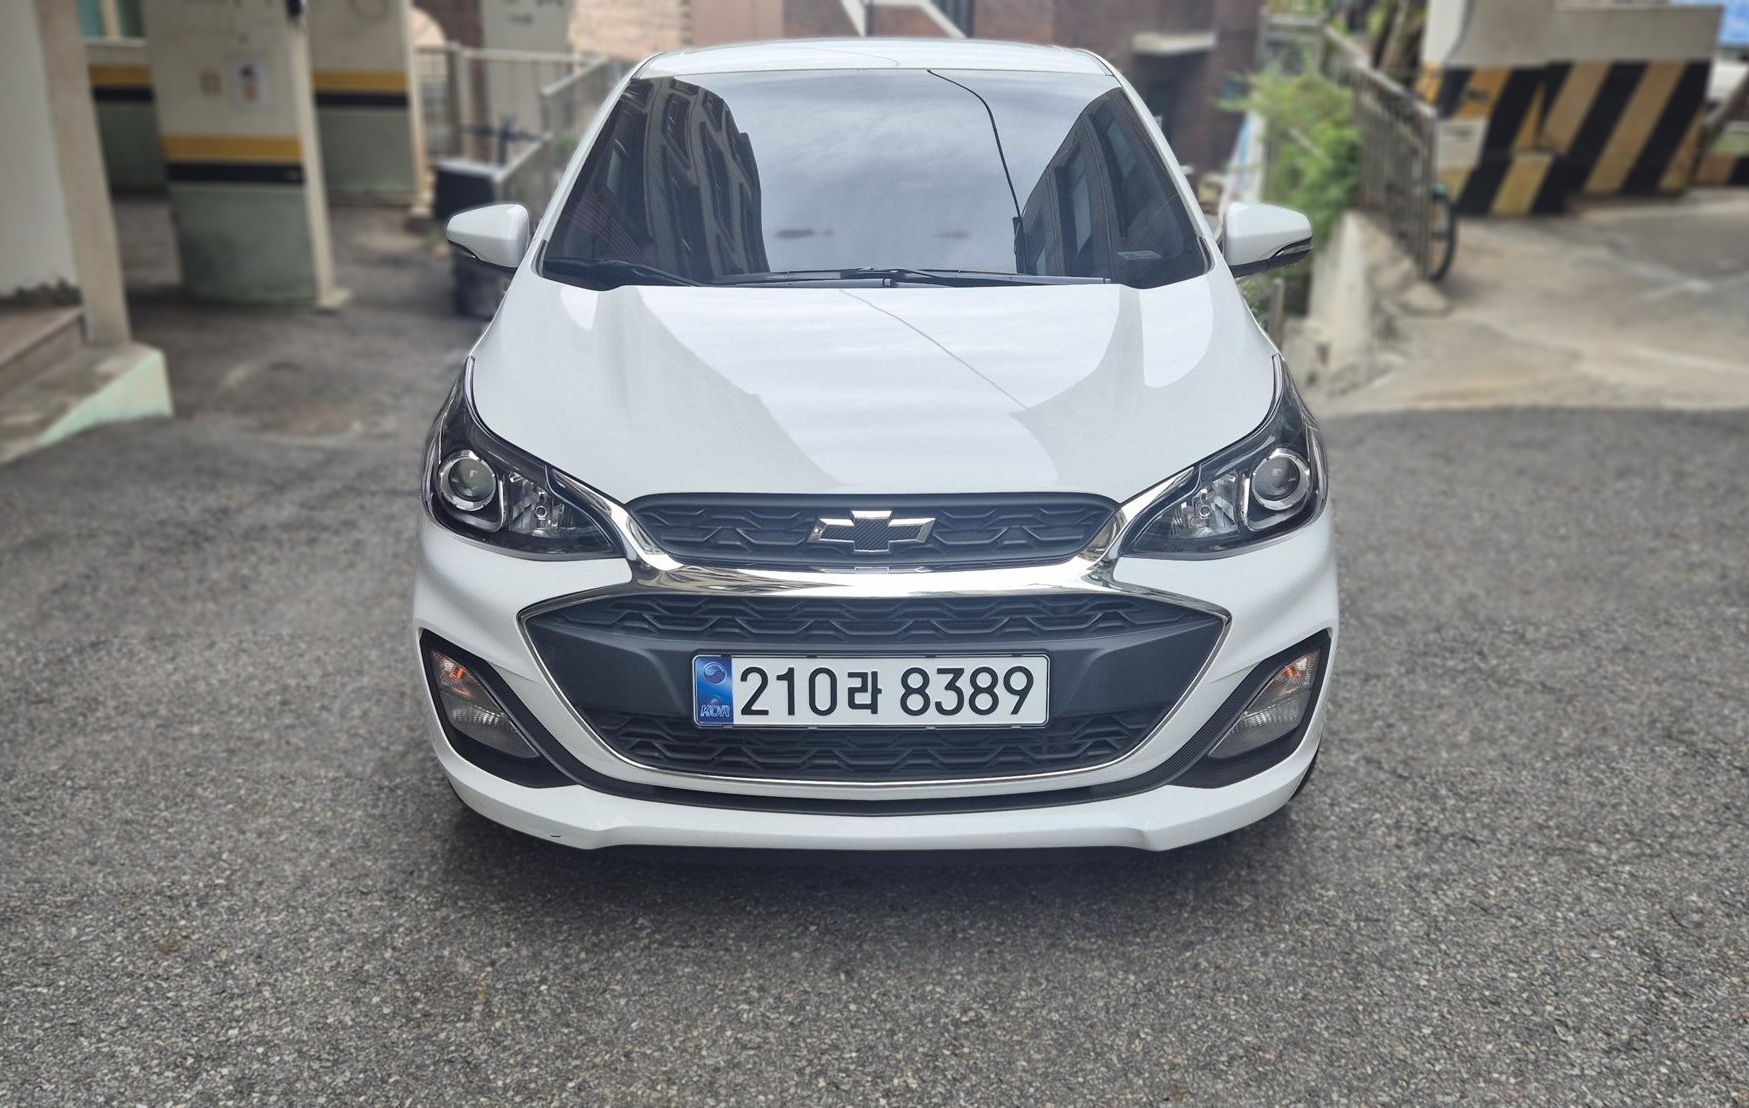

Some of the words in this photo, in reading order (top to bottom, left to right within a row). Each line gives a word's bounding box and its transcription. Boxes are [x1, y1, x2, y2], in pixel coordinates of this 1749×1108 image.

[739, 666, 882, 716] 210라
[900, 665, 1035, 716] 8389
[700, 704, 730, 717] KOR
